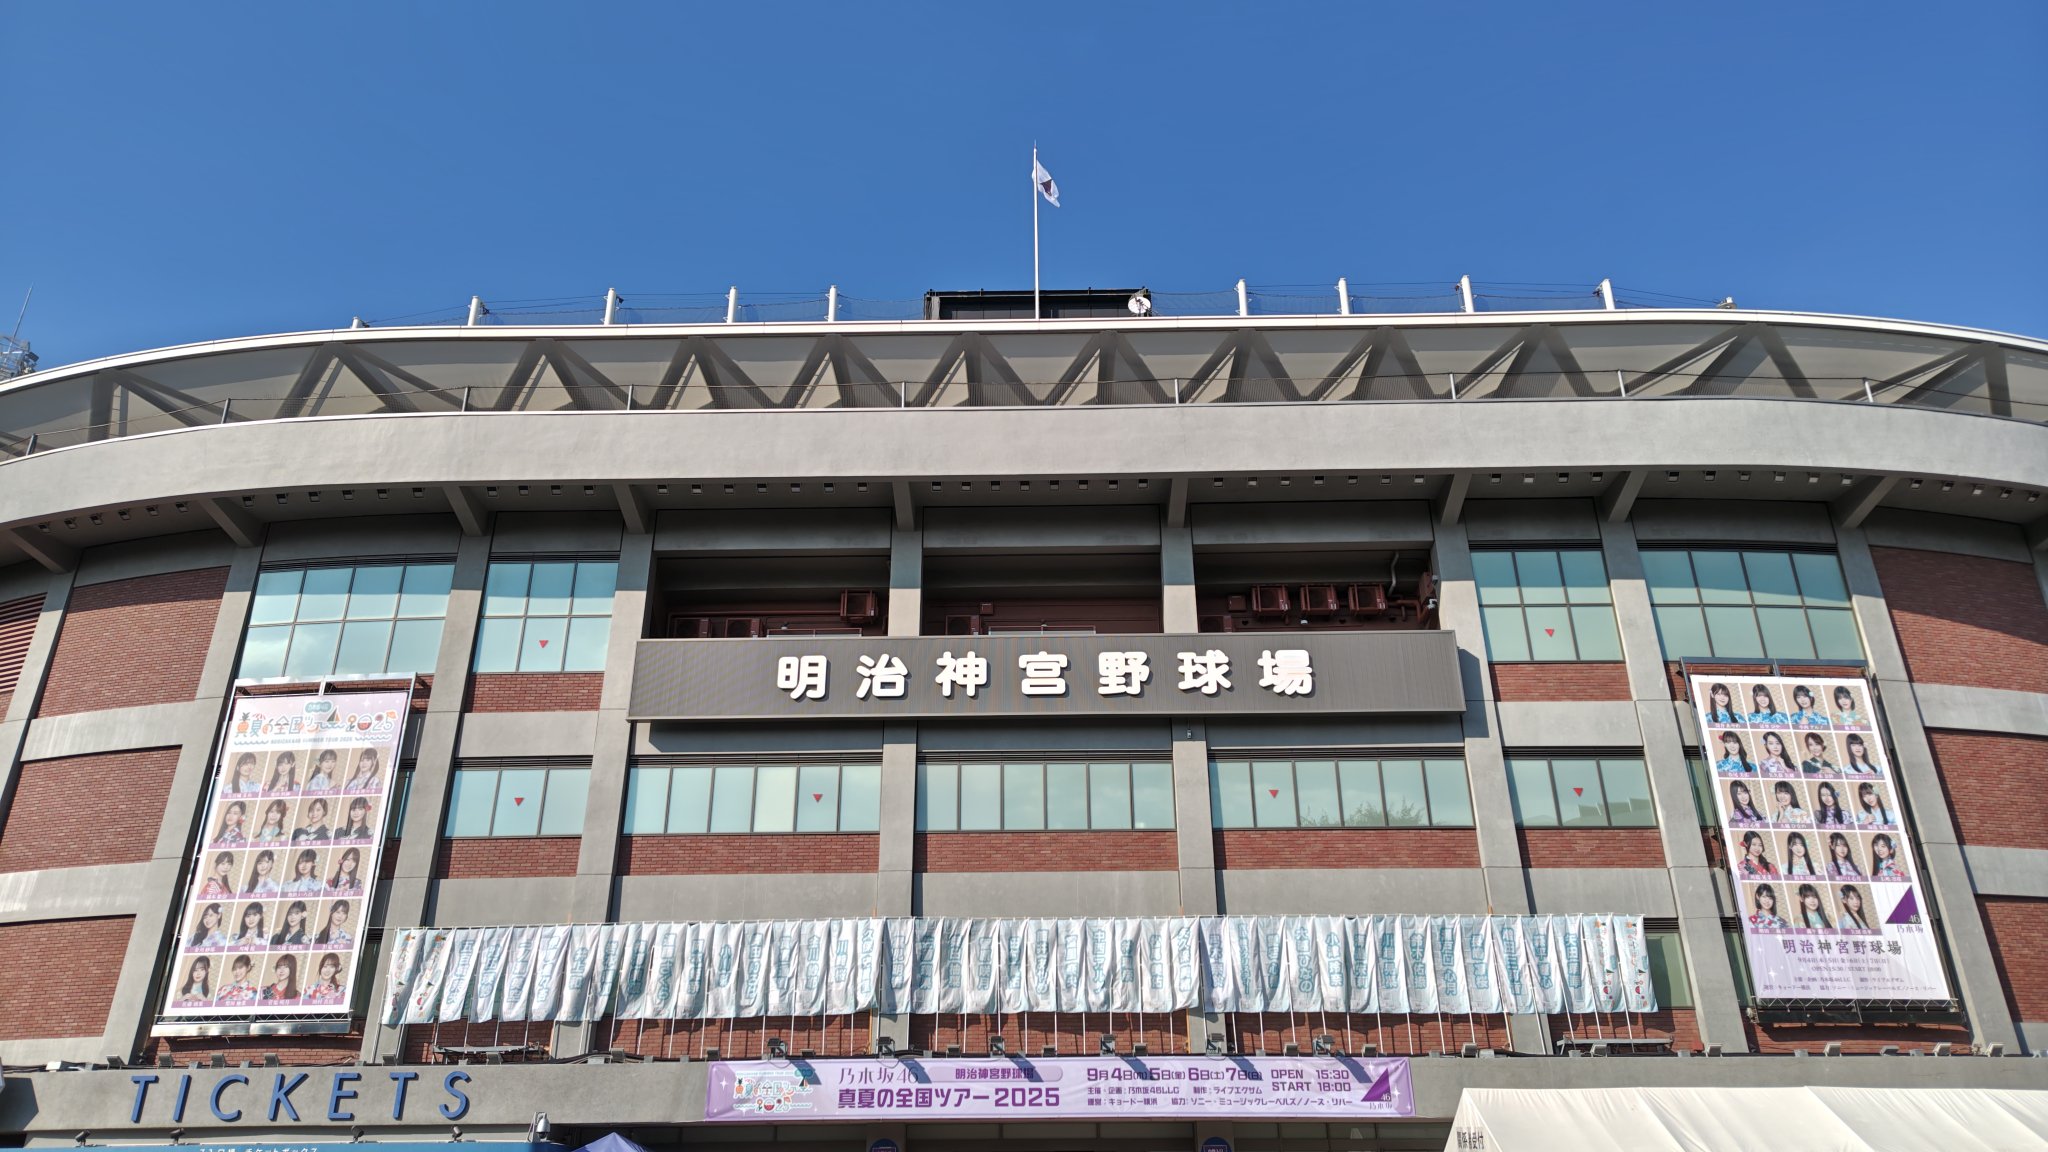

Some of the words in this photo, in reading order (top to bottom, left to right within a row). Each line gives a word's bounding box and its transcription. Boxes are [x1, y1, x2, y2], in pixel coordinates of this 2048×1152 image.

[777, 650, 1312, 699] 明治神宮野球場
[1908, 914, 1921, 923] 46
[1783, 939, 1902, 956] 明治神宮野球場
[839, 1067, 918, 1084] 乃木坂46
[955, 1068, 1034, 1080] 明治神宮野球場
[1271, 1069, 1304, 1079] OPEN
[1316, 1069, 1349, 1080] 15:30
[1272, 1082, 1311, 1091] START
[1317, 1082, 1351, 1091] 18:00
[131, 1071, 472, 1124] TICKETS
[1381, 1093, 1392, 1102] 46
